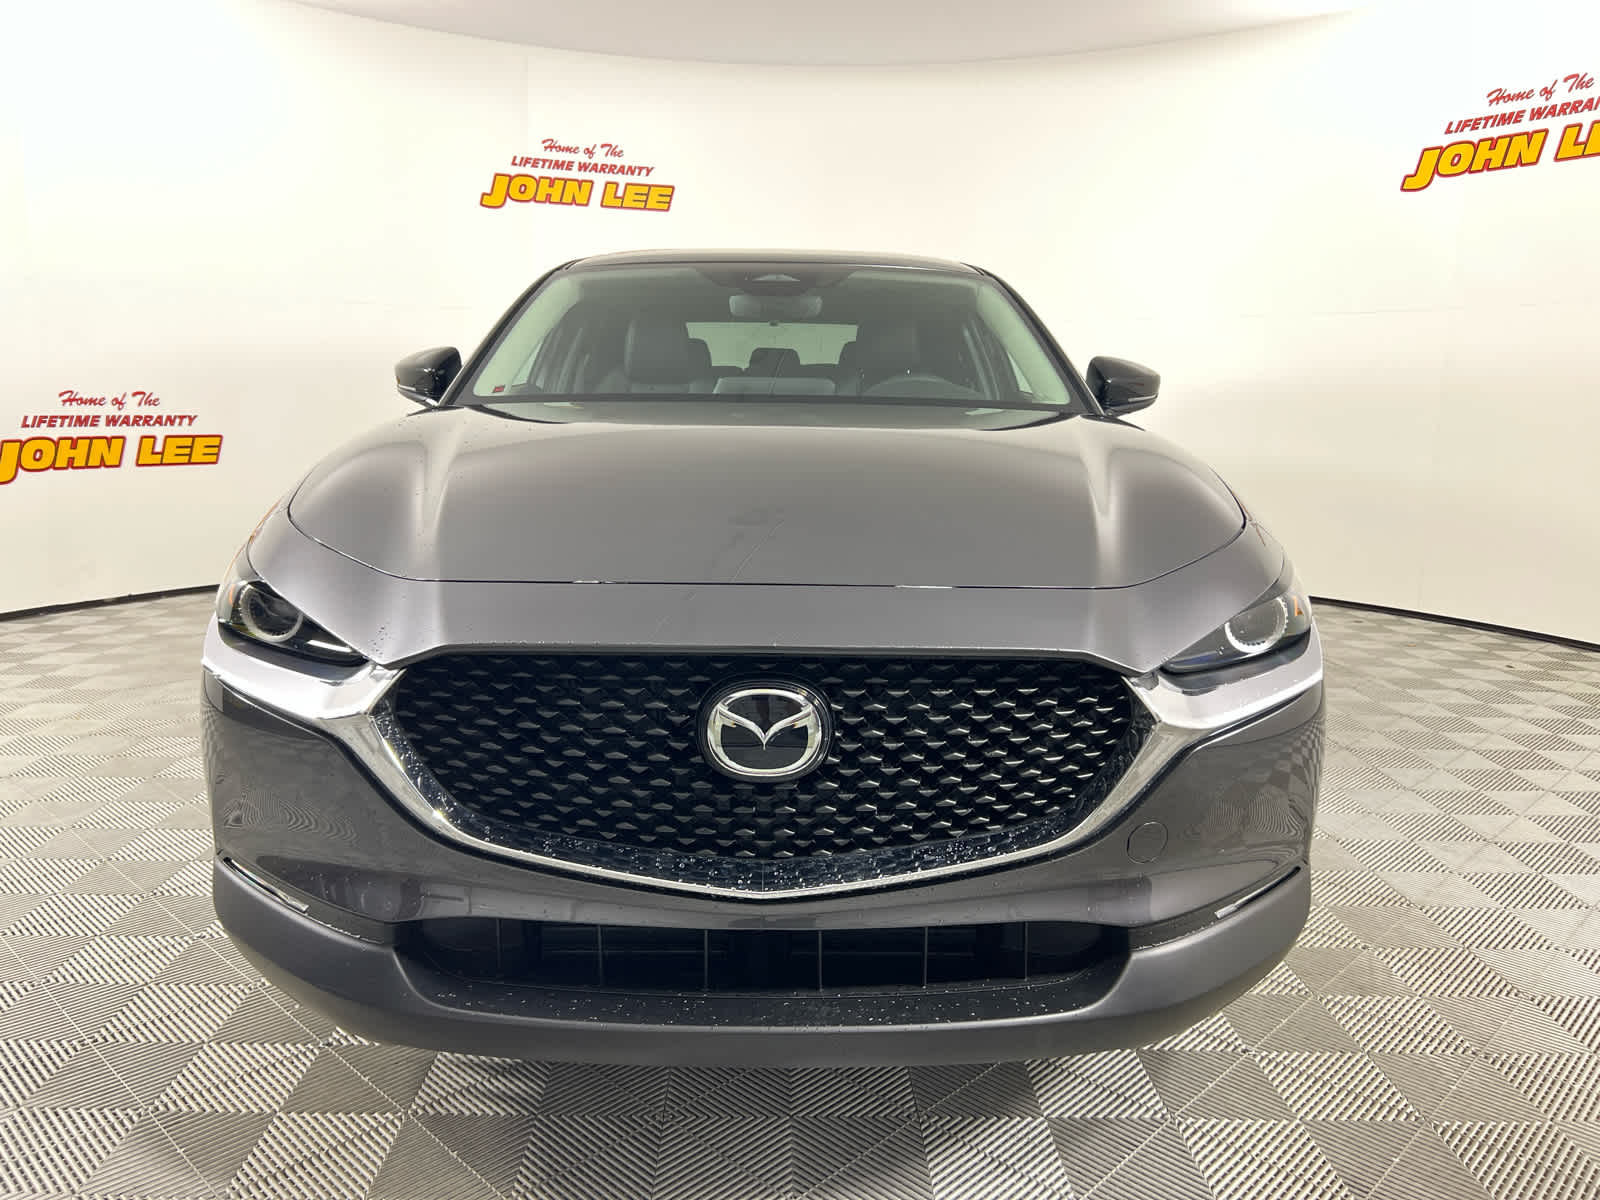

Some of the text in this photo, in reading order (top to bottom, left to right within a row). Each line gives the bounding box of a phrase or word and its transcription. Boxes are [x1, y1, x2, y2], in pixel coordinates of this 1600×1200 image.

[1486, 72, 1594, 107] Home of The
[1444, 109, 1526, 135] LIFETIME
[542, 138, 624, 159] Home of The
[1400, 128, 1549, 192] JOHN
[511, 155, 654, 177] LIFETIME WARRANTY
[480, 173, 675, 212] JOHN LEE
[58, 390, 160, 411] Home of The
[21, 414, 198, 429] LIFETIME WARRANTY
[0, 435, 223, 485] JOHN LEE
